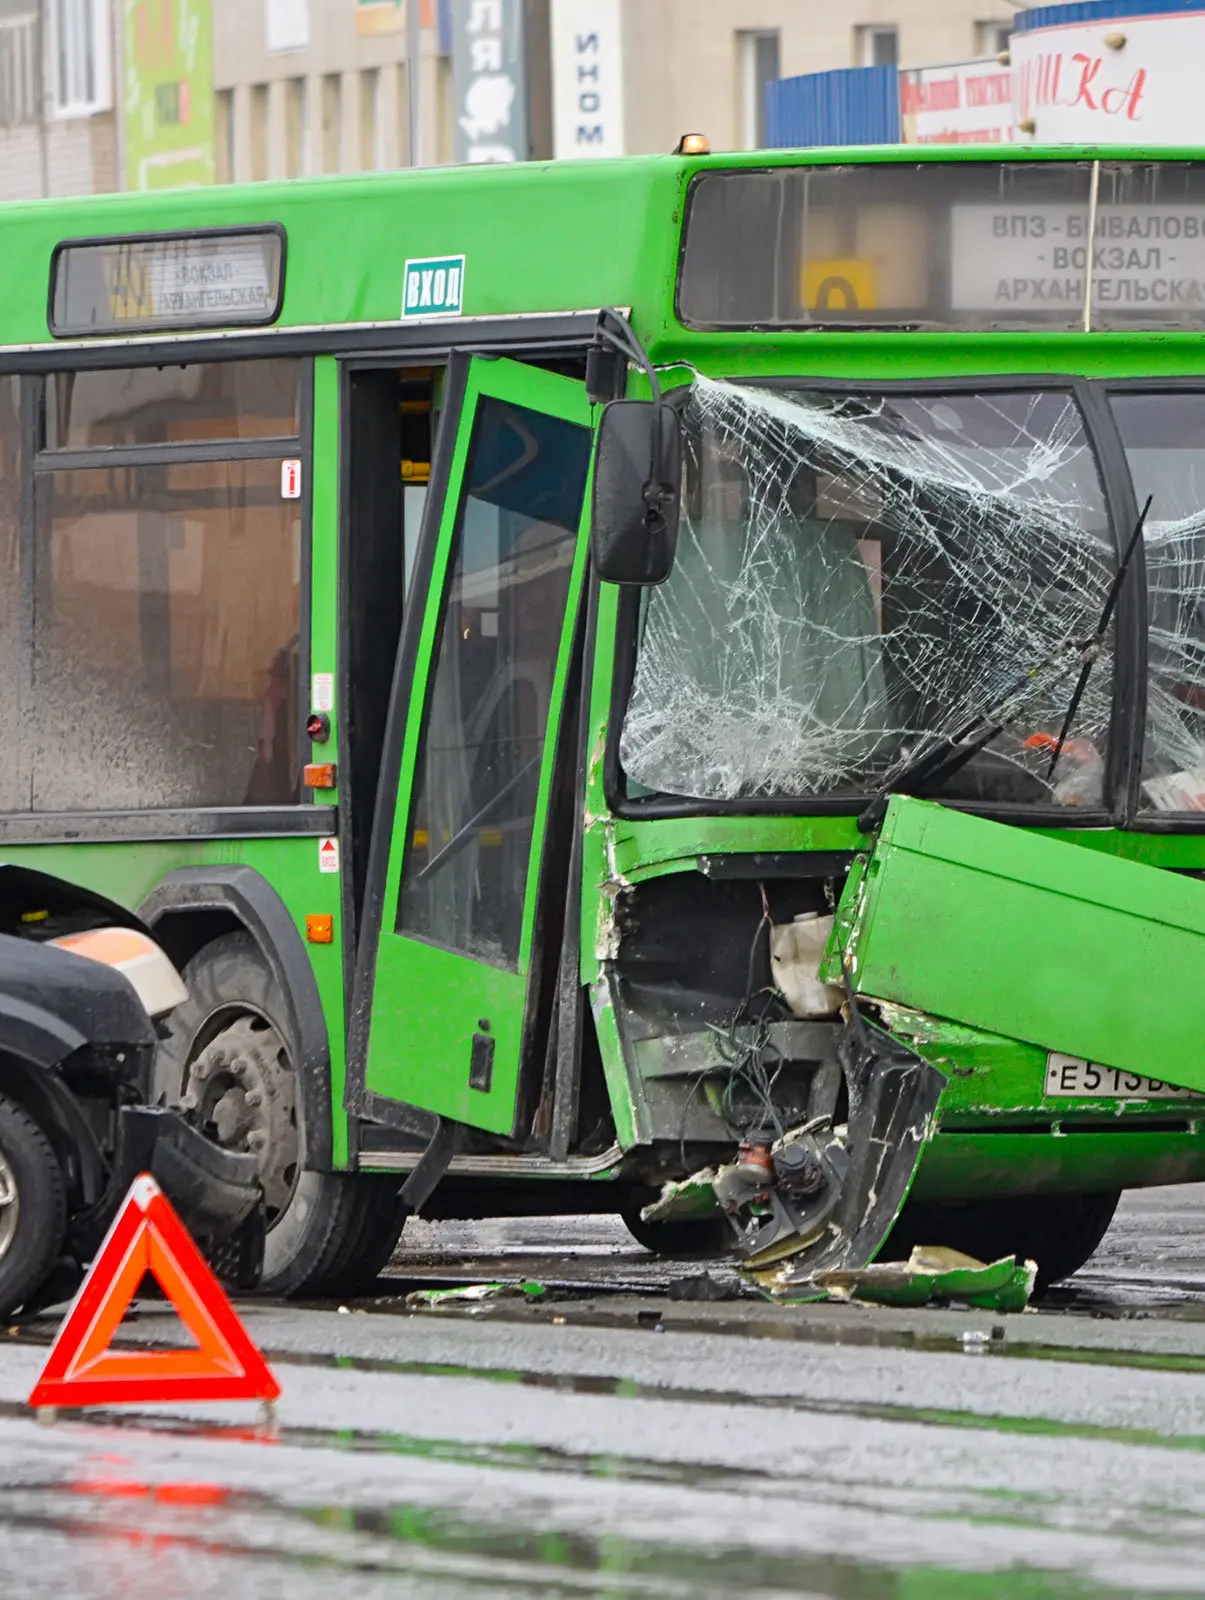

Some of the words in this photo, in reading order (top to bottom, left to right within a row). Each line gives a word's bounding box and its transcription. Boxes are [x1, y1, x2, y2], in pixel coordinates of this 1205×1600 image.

[1053, 247, 1162, 271] ВОКЗАЛ
[406, 267, 461, 308] ВХОД
[994, 278, 1205, 302] АРХАНЕЛЬСКА
